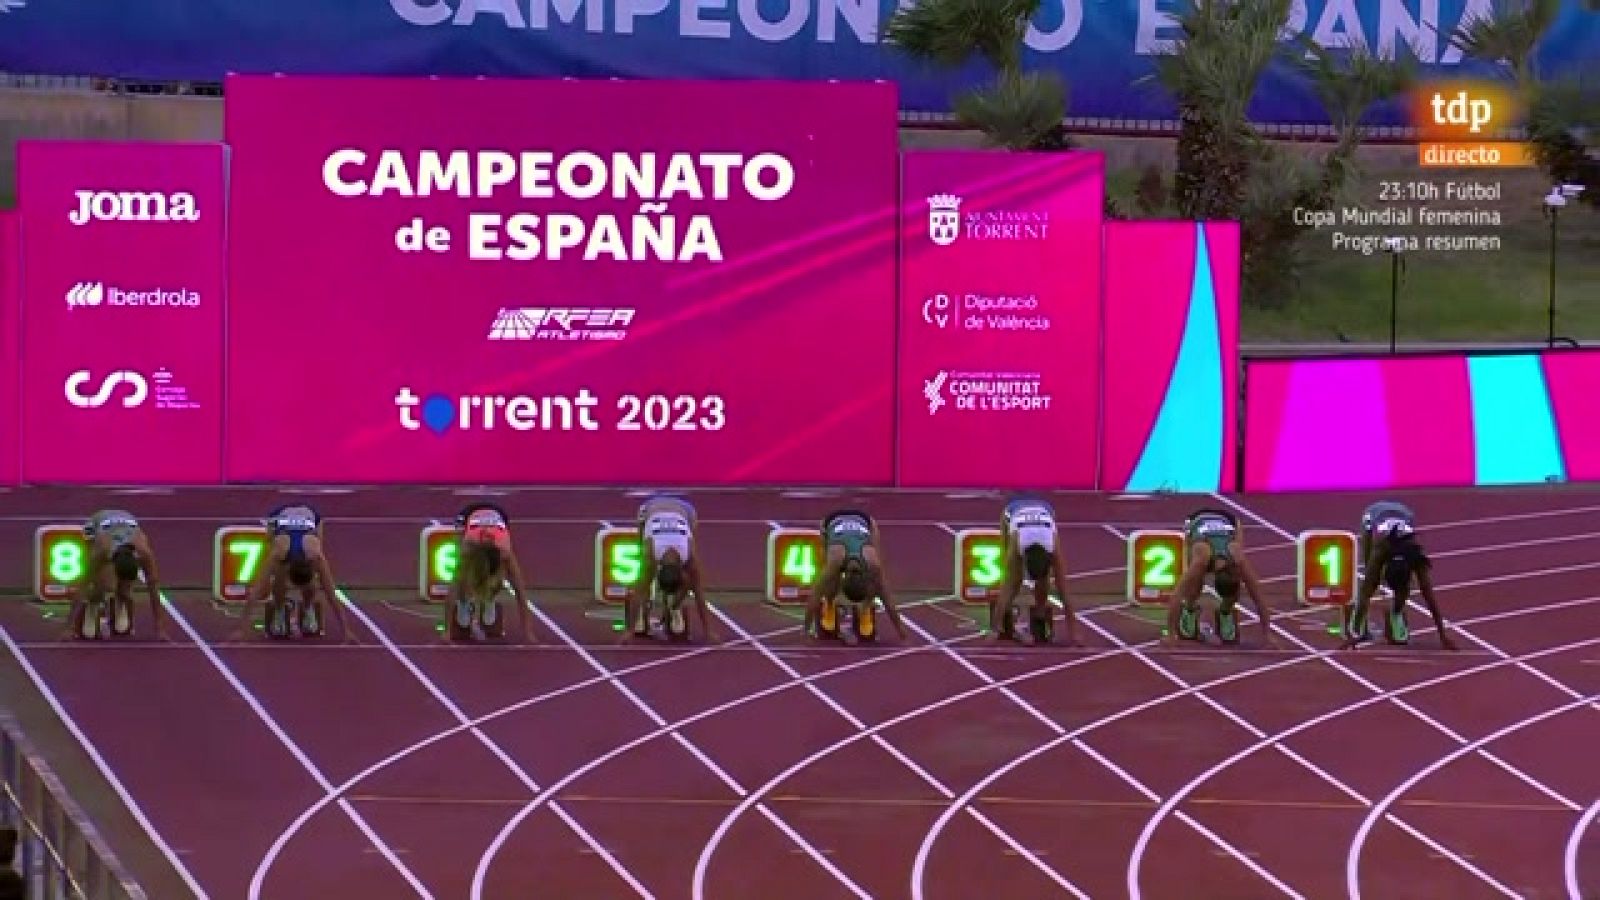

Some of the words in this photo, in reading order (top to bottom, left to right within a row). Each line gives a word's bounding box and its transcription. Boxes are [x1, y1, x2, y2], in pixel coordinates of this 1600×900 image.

[322, 148, 795, 201] CAMPEONATO
[395, 217, 451, 252] de
[469, 202, 724, 261] ESPAÑA
[965, 224, 1049, 241] TORRENT
[107, 287, 201, 307] Iberdrola
[964, 294, 1038, 312] Diputació
[964, 314, 983, 330] de
[949, 381, 1040, 396] COMUNITAT
[957, 396, 976, 411] DE
[980, 395, 1051, 411] L'ESPORT
[617, 394, 726, 431] 2023
[50, 540, 82, 582] 8
[228, 540, 264, 583] 7
[610, 542, 642, 584] 5
[781, 543, 816, 585] 4
[968, 544, 1002, 586] 3
[1143, 545, 1176, 586] 2
[1318, 544, 1342, 587] 1
